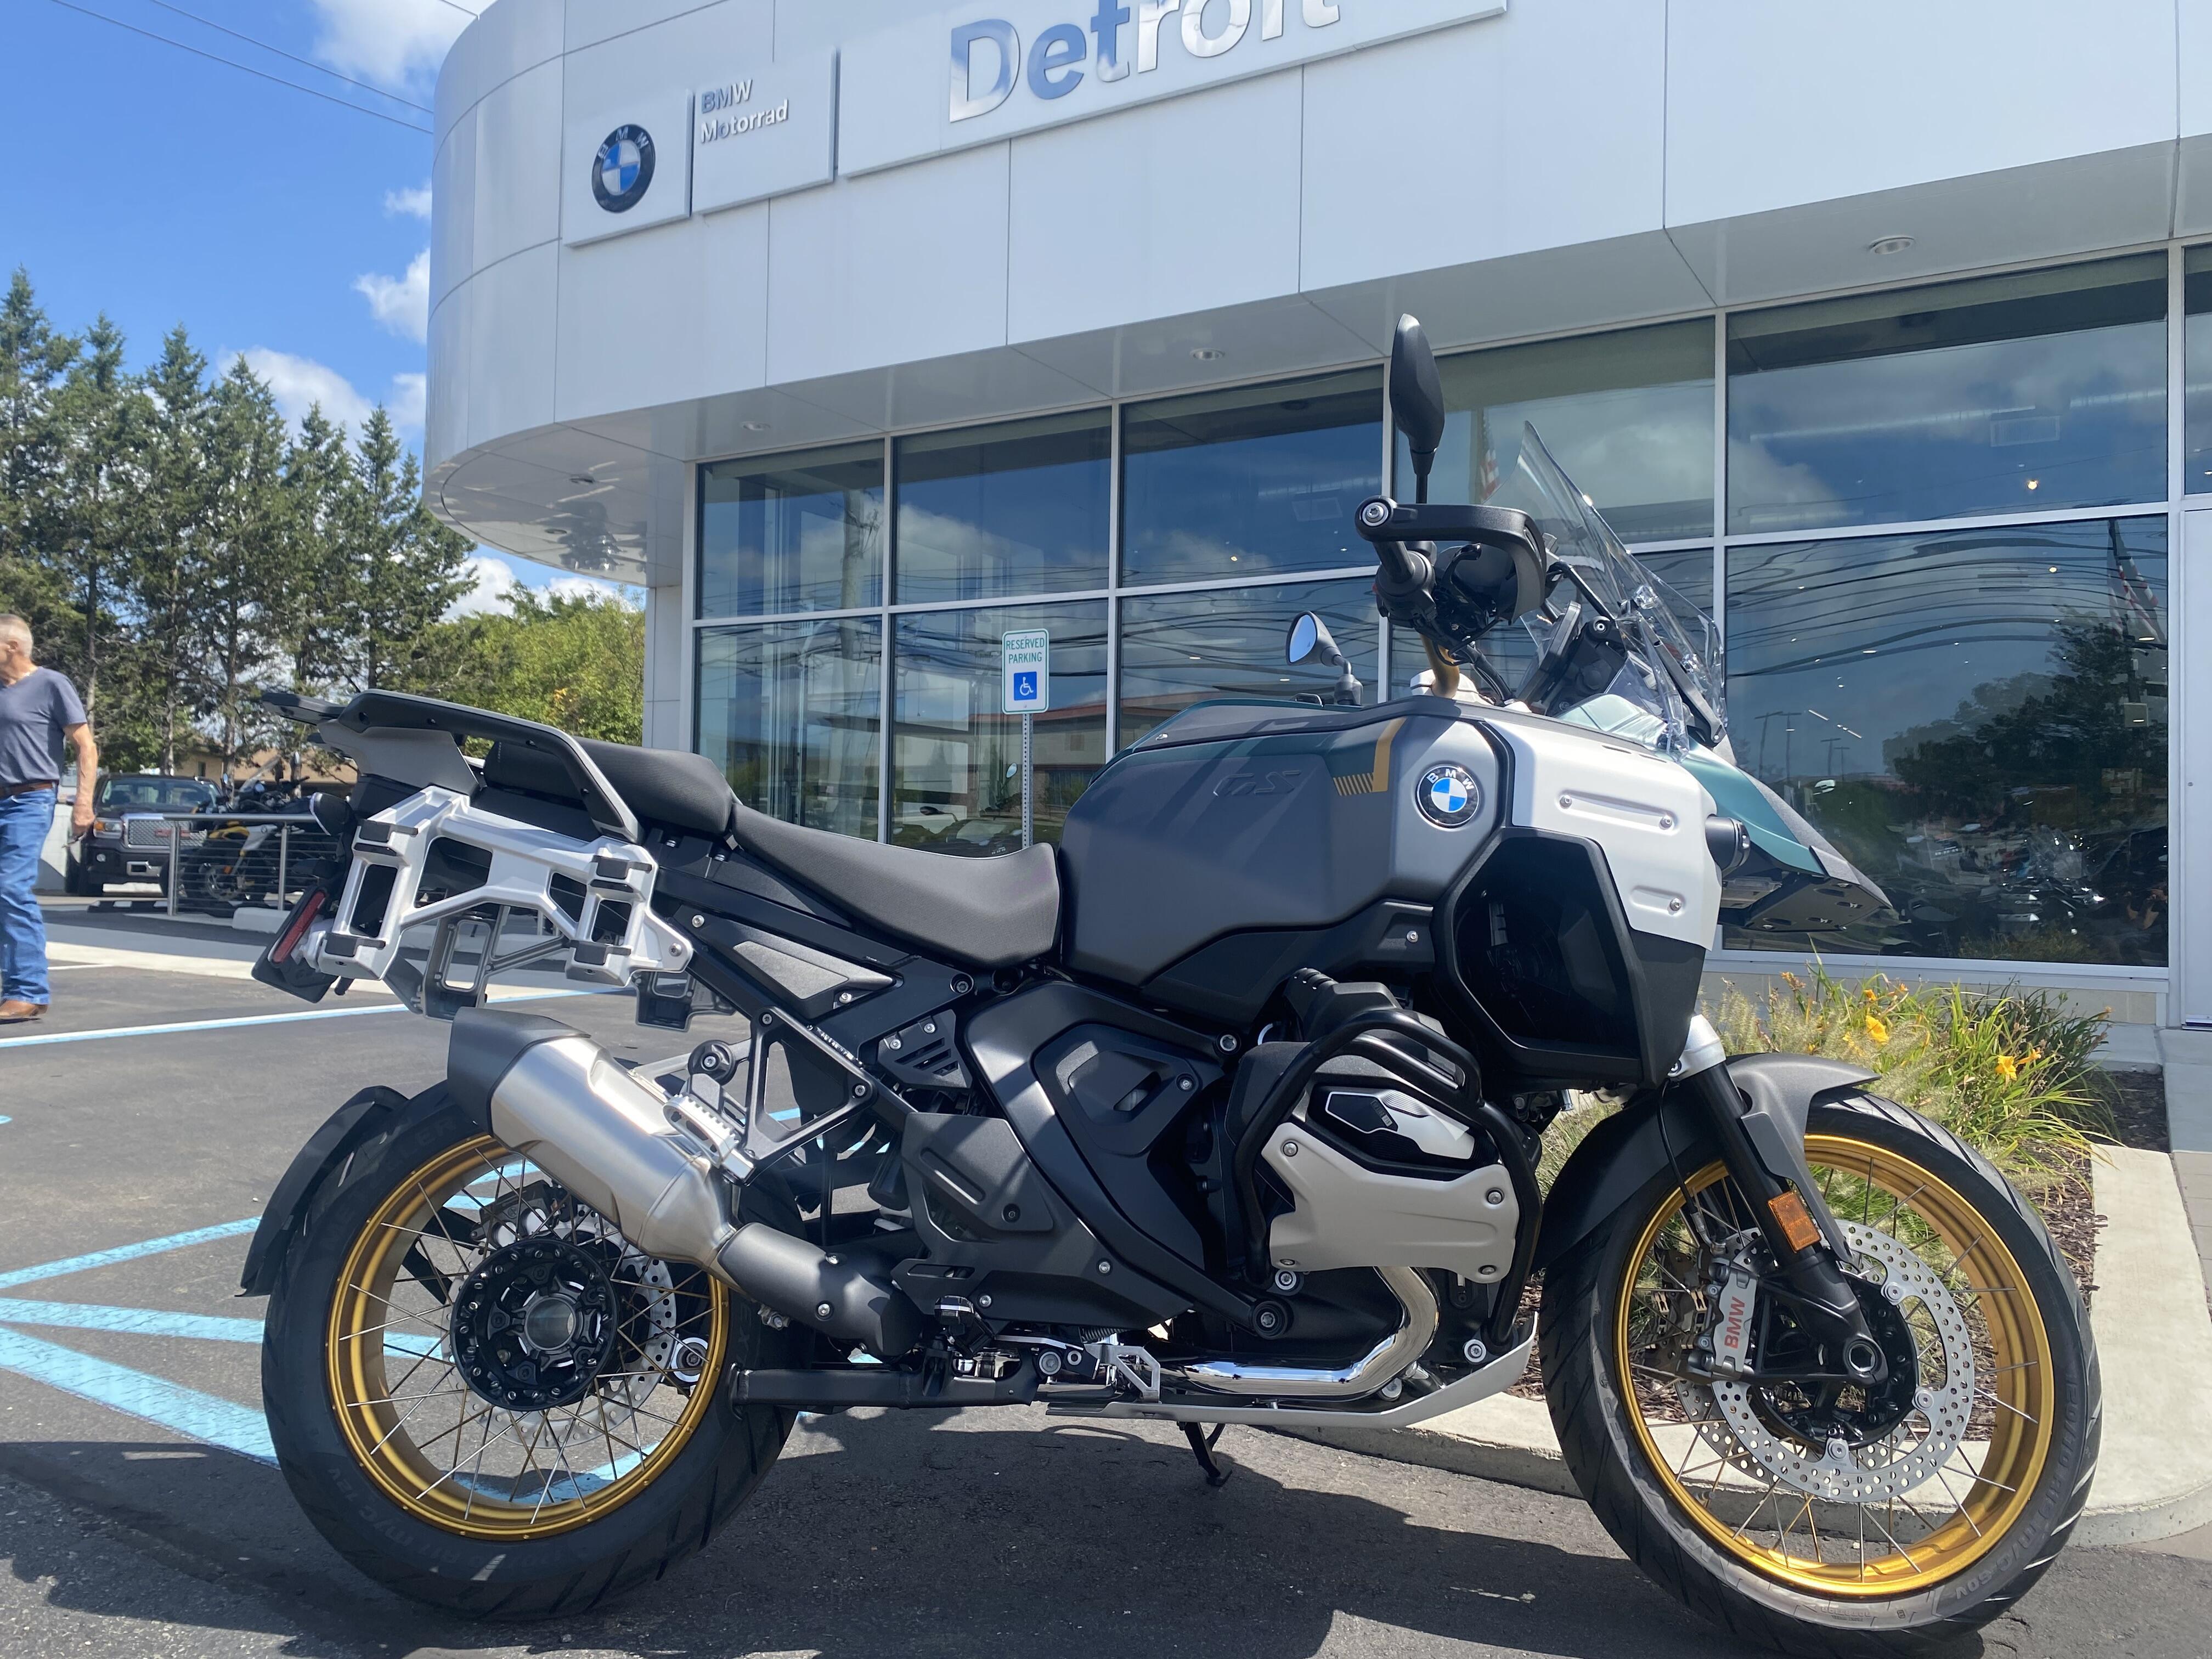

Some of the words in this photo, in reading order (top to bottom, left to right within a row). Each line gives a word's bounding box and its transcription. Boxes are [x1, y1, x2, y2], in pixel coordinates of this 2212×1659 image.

[701, 78, 753, 114] BMW
[701, 99, 788, 144] Motorrad
[1006, 637, 1045, 650] RESERVED
[1008, 652, 1042, 664] PARKING
[1426, 768, 1475, 790] BMW
[1724, 1296, 1745, 1348] BMW
